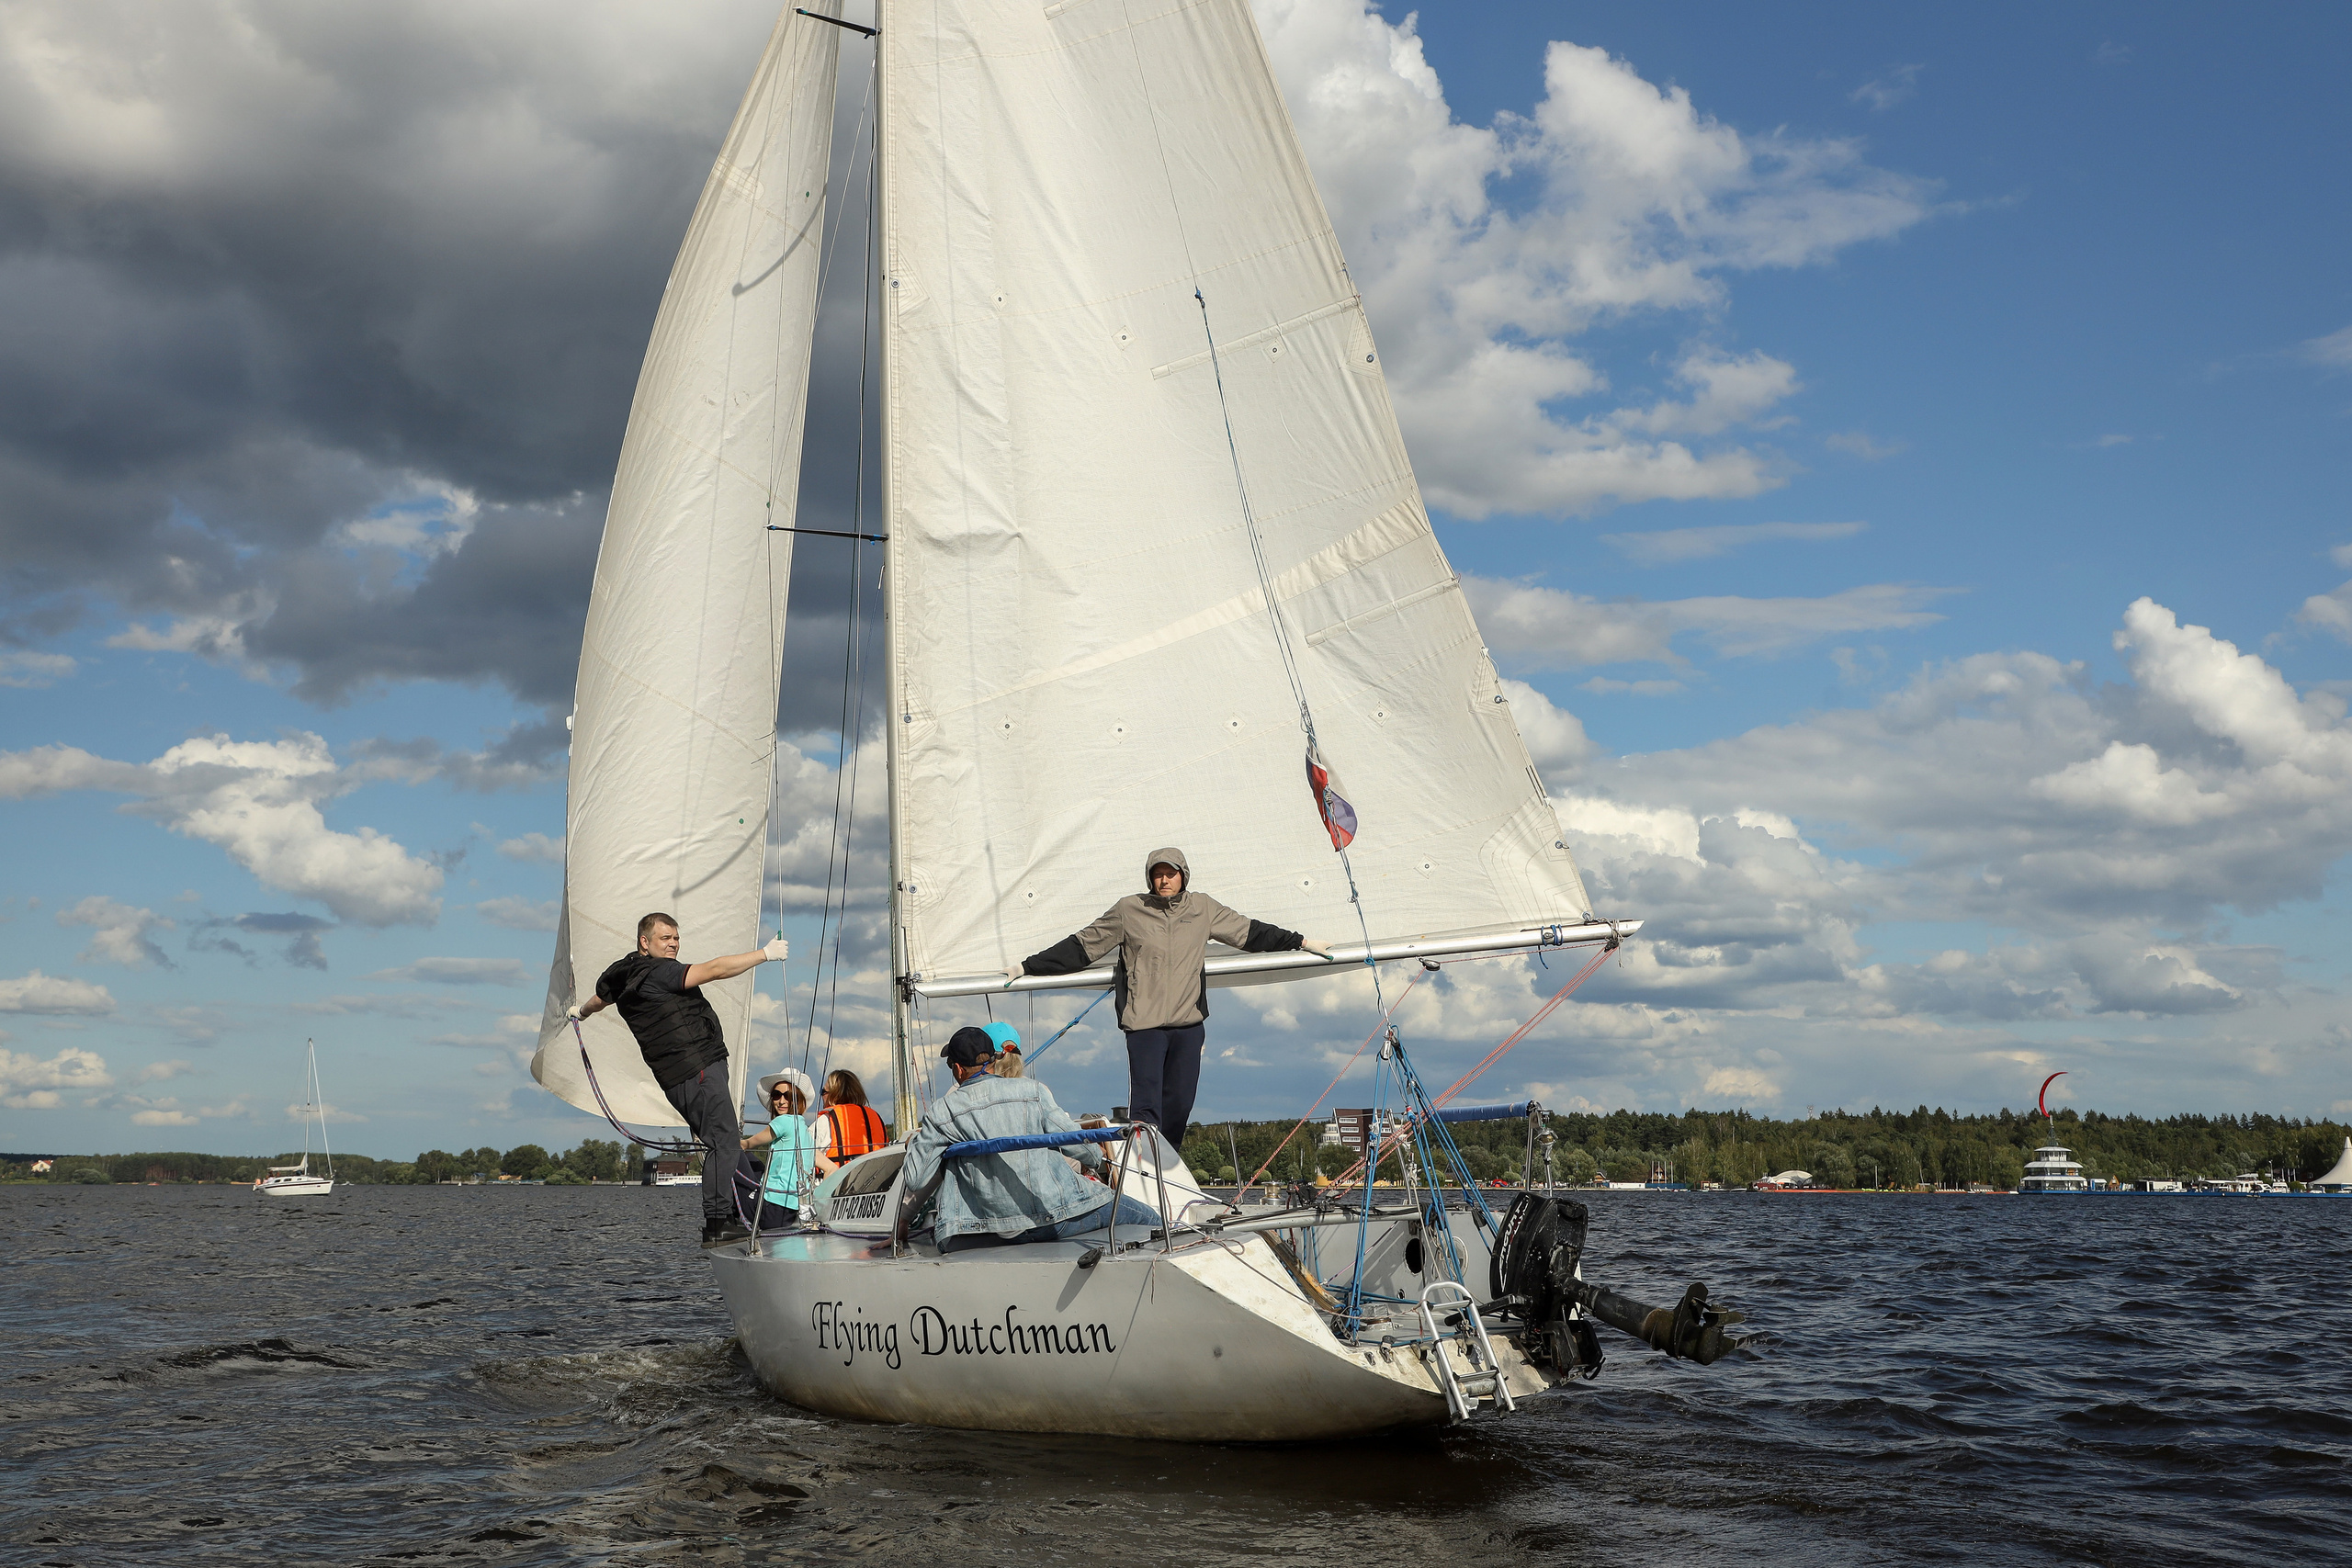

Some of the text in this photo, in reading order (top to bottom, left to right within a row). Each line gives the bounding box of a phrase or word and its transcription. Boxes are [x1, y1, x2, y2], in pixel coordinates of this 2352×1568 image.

[837, 1196, 860, 1221] 07-02
[812, 1301, 1116, 1370] Flying Dutchman
